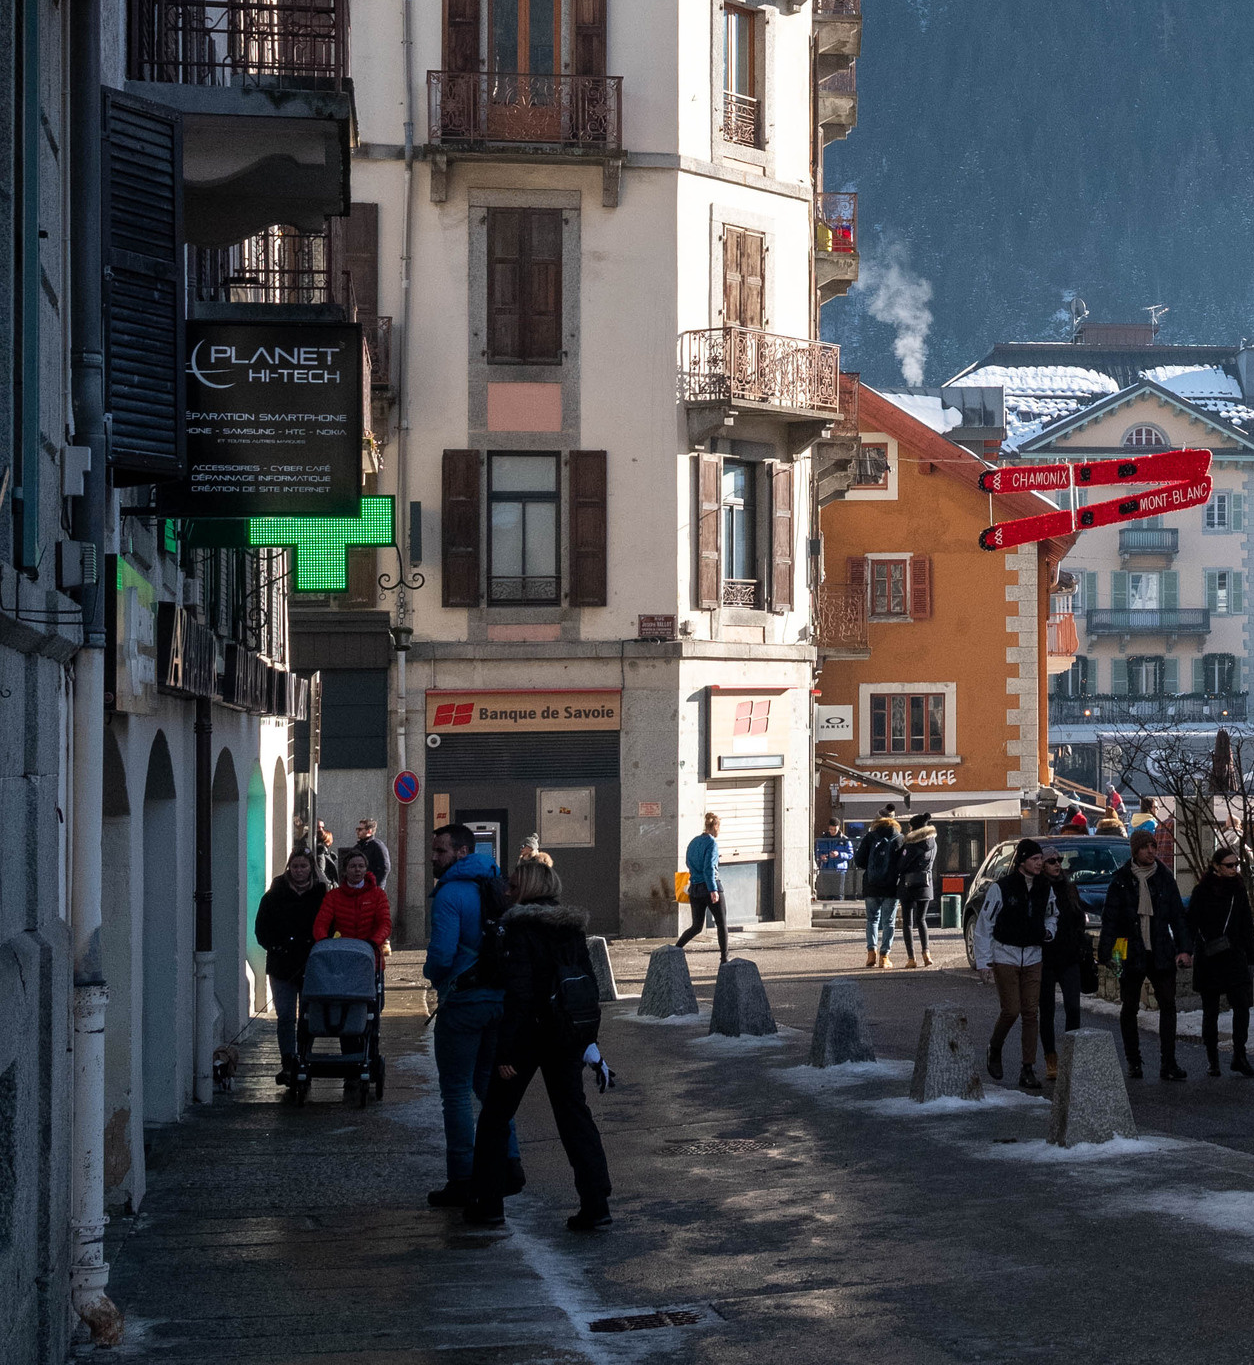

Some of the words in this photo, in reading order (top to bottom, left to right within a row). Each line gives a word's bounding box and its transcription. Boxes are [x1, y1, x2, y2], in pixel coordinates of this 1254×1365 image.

[210, 346, 340, 365] PLANET
[249, 369, 340, 384] HI-TECH
[259, 413, 347, 422] SMARTPHONE
[222, 427, 275, 435] SAMSUNG
[305, 464, 331, 472] CAFÉ
[191, 473, 255, 482] DÉPANNAGE
[1012, 470, 1067, 487] CHAMONIX
[191, 484, 239, 493] CRÉATION
[1139, 482, 1208, 511] MONT-BLANC
[479, 707, 537, 723] Banque
[541, 706, 559, 719] de
[564, 705, 614, 719] Savoie
[917, 769, 957, 787] CAFE
